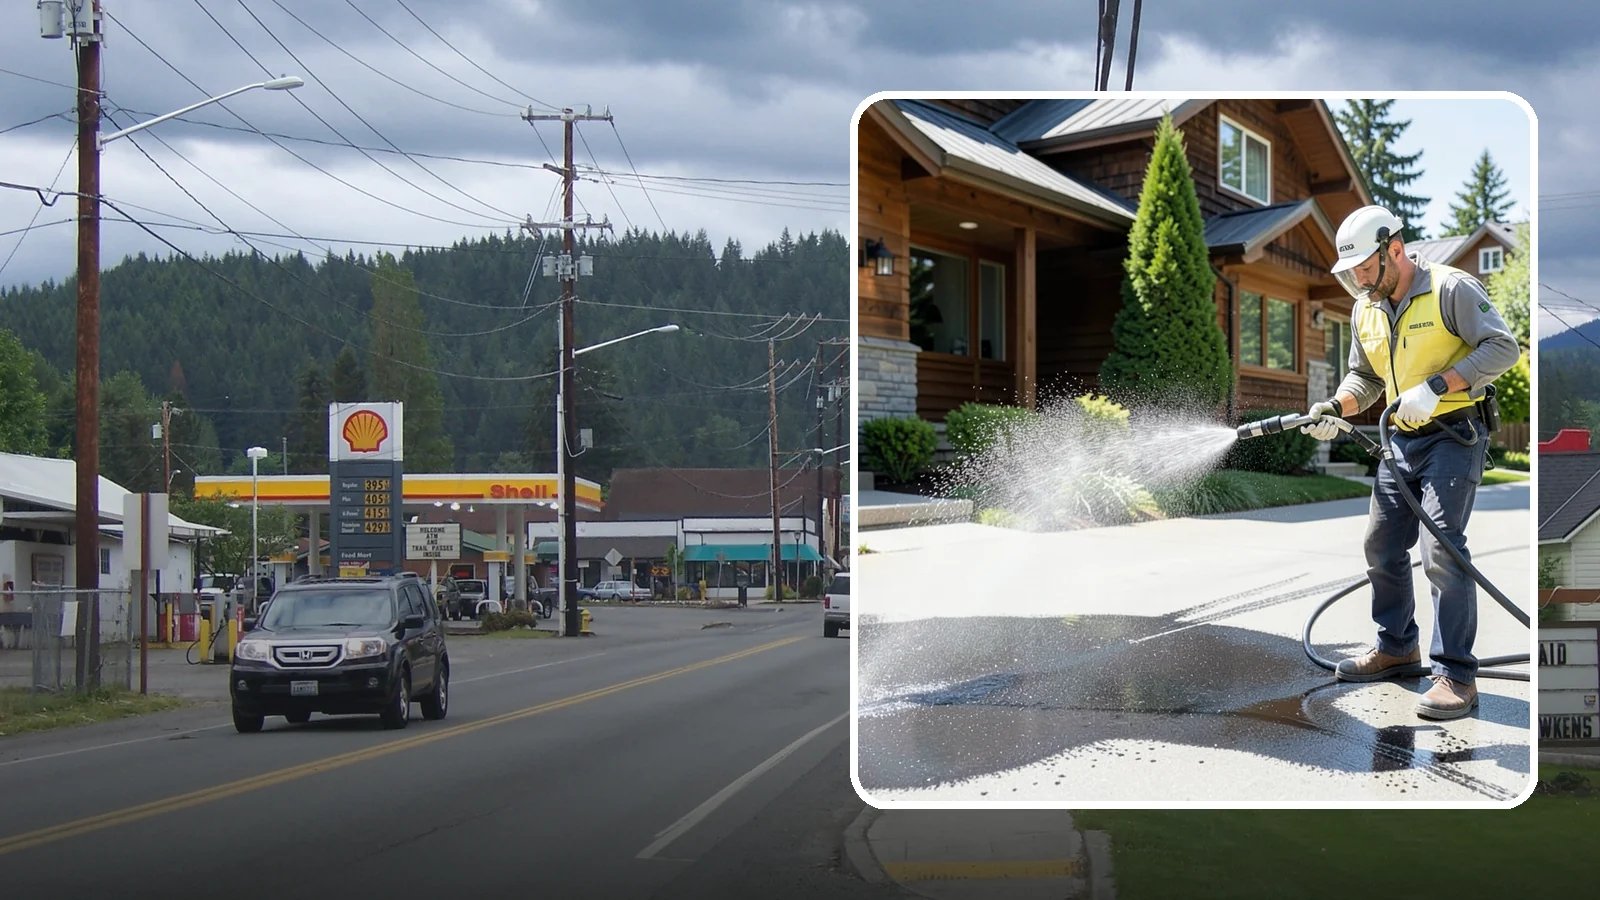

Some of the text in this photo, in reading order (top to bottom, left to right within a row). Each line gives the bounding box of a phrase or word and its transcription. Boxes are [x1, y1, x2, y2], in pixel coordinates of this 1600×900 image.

[366, 480, 383, 490] 395
[490, 484, 547, 499] Shell
[366, 494, 383, 504] 405
[366, 508, 383, 518] 415
[366, 522, 383, 532] 429
[1539, 643, 1567, 665] AID
